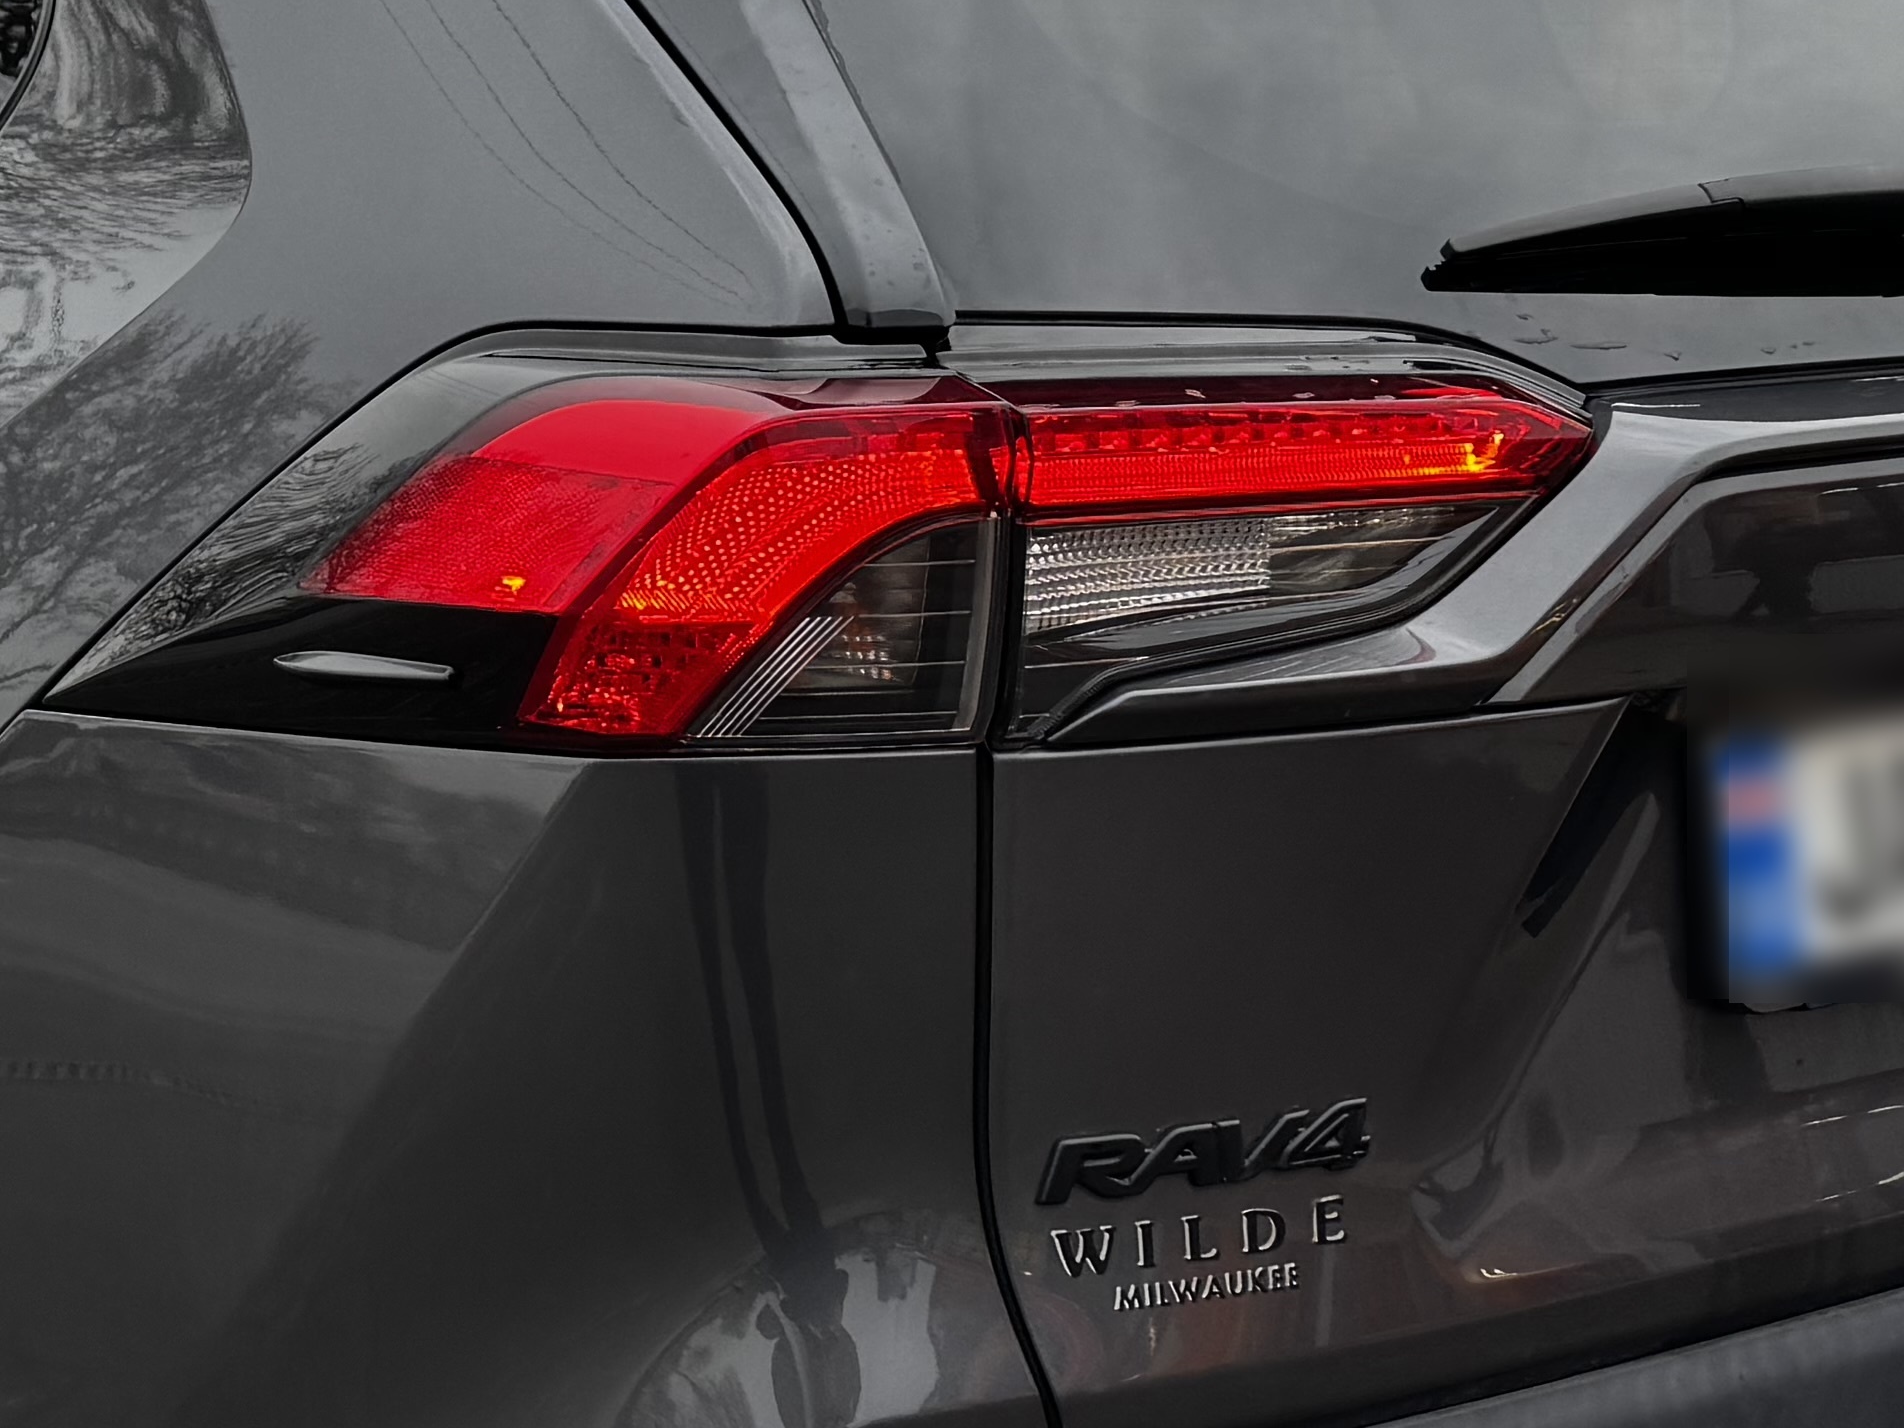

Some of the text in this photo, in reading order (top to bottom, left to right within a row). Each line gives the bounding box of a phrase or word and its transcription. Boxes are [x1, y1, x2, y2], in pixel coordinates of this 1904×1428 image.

[1034, 1096, 1371, 1205] RAV4
[1050, 1193, 1348, 1279] WILDE
[1113, 1262, 1300, 1312] MILWAUKEE
